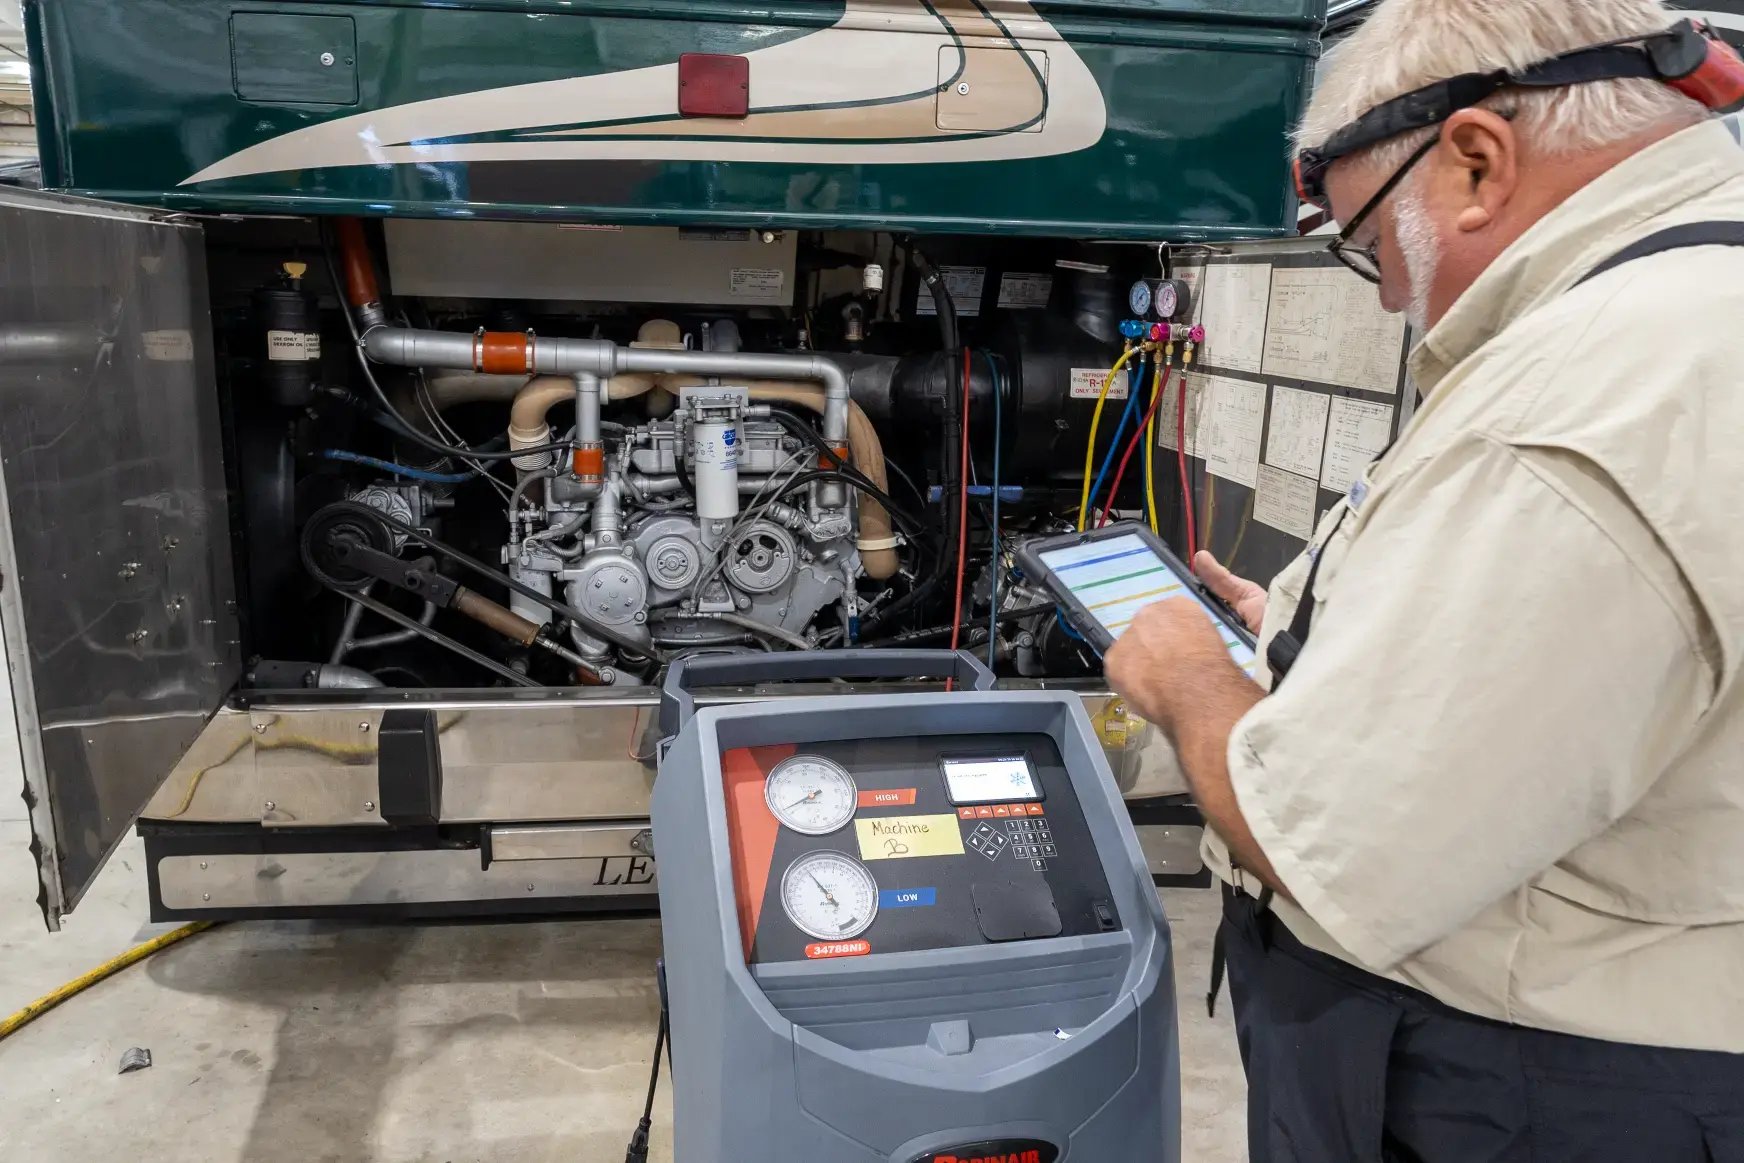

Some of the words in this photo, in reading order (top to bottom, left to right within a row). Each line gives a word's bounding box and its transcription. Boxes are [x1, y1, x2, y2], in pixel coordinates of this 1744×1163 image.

[875, 793, 899, 802] HIGH
[871, 821, 930, 837] Machine
[883, 838, 909, 857] B
[897, 893, 918, 902] LOW
